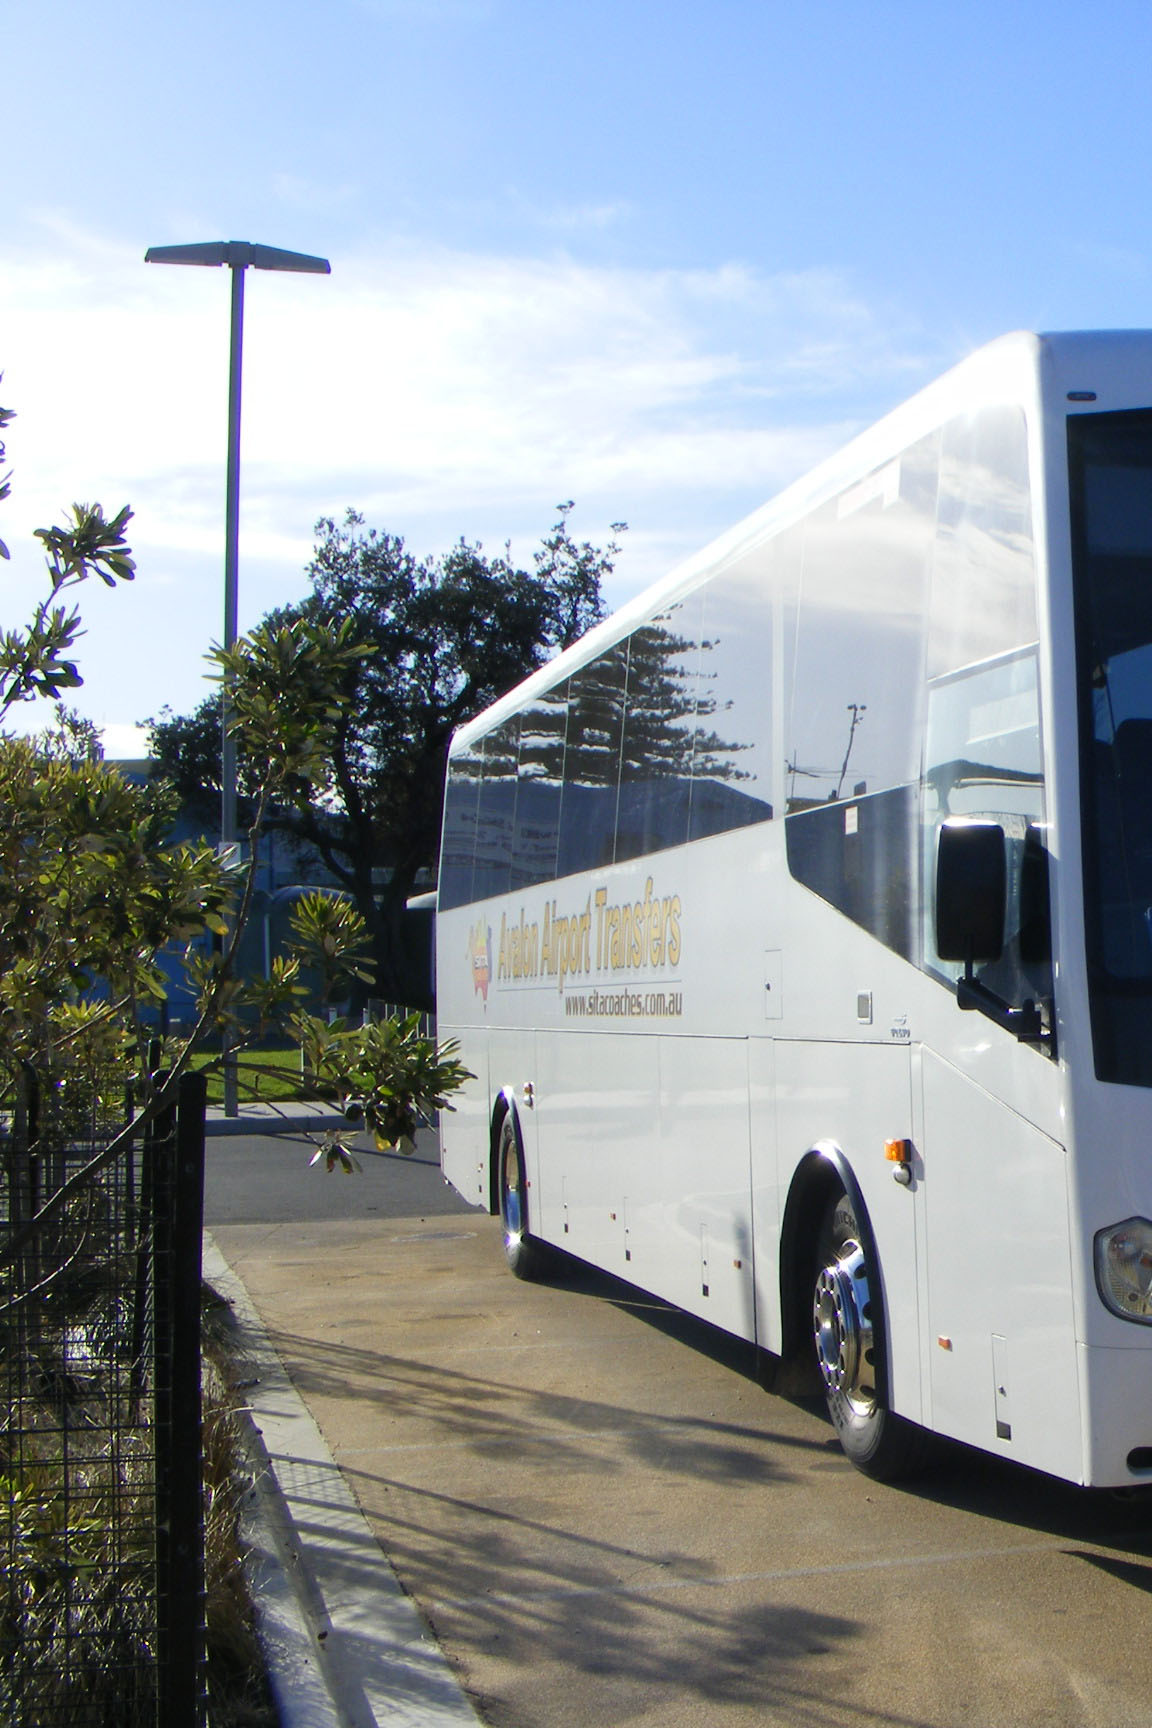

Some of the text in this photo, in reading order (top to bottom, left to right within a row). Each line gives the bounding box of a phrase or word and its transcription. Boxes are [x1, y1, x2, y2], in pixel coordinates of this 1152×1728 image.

[498, 876, 682, 994] Avalon Airport Transfers
[565, 988, 683, 1017] www.sitacoaches.com.au
